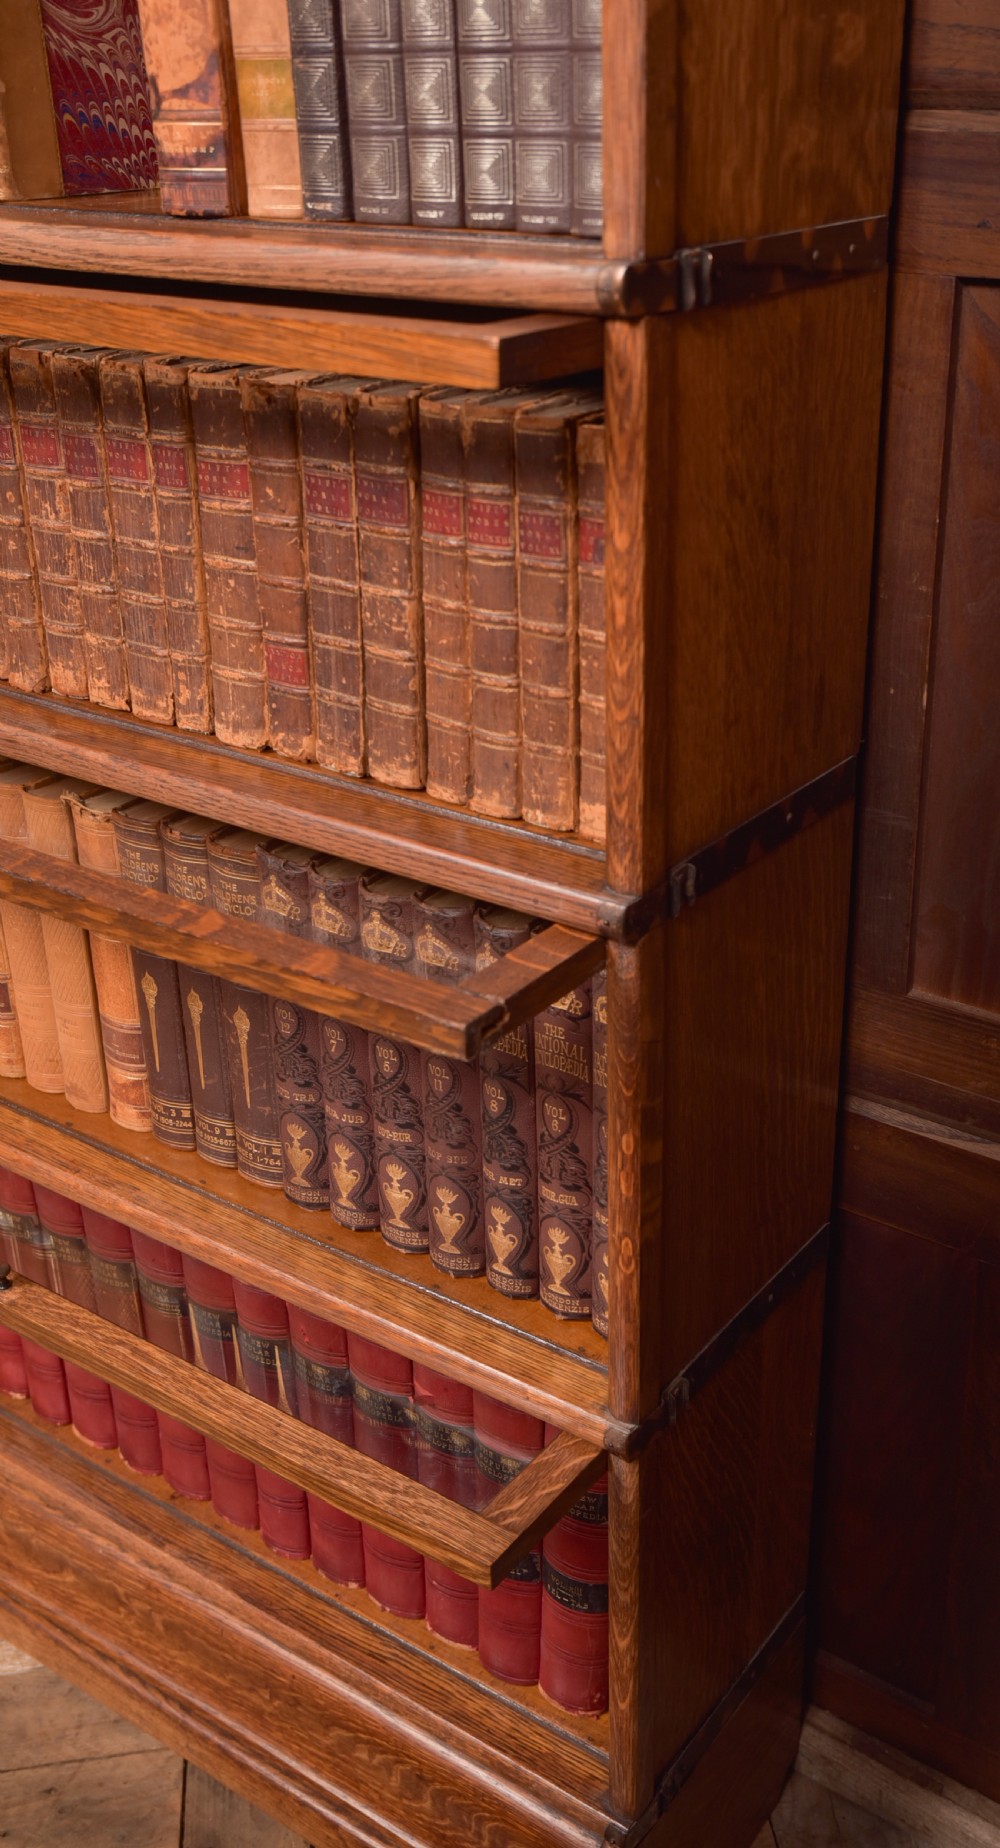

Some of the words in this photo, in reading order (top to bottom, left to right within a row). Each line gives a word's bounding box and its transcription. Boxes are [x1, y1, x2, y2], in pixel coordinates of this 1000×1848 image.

[124, 848, 141, 861] THE
[172, 862, 188, 874] THE
[219, 879, 238, 893] THE
[276, 1007, 295, 1022] VOL
[280, 1021, 291, 1034] 12
[325, 1025, 344, 1042] VOL
[543, 1022, 565, 1040] THE
[329, 1040, 338, 1053] 7
[376, 1045, 398, 1062] VOL
[428, 1063, 450, 1080] VOL
[293, 1092, 316, 1102] TRA
[485, 1083, 505, 1101] VOL
[490, 1099, 499, 1113] 8
[544, 1103, 567, 1121] VOL
[170, 1108, 178, 1118] 3
[341, 1114, 366, 1125] JUR
[214, 1127, 221, 1135] 9
[498, 1176, 523, 1187] MET
